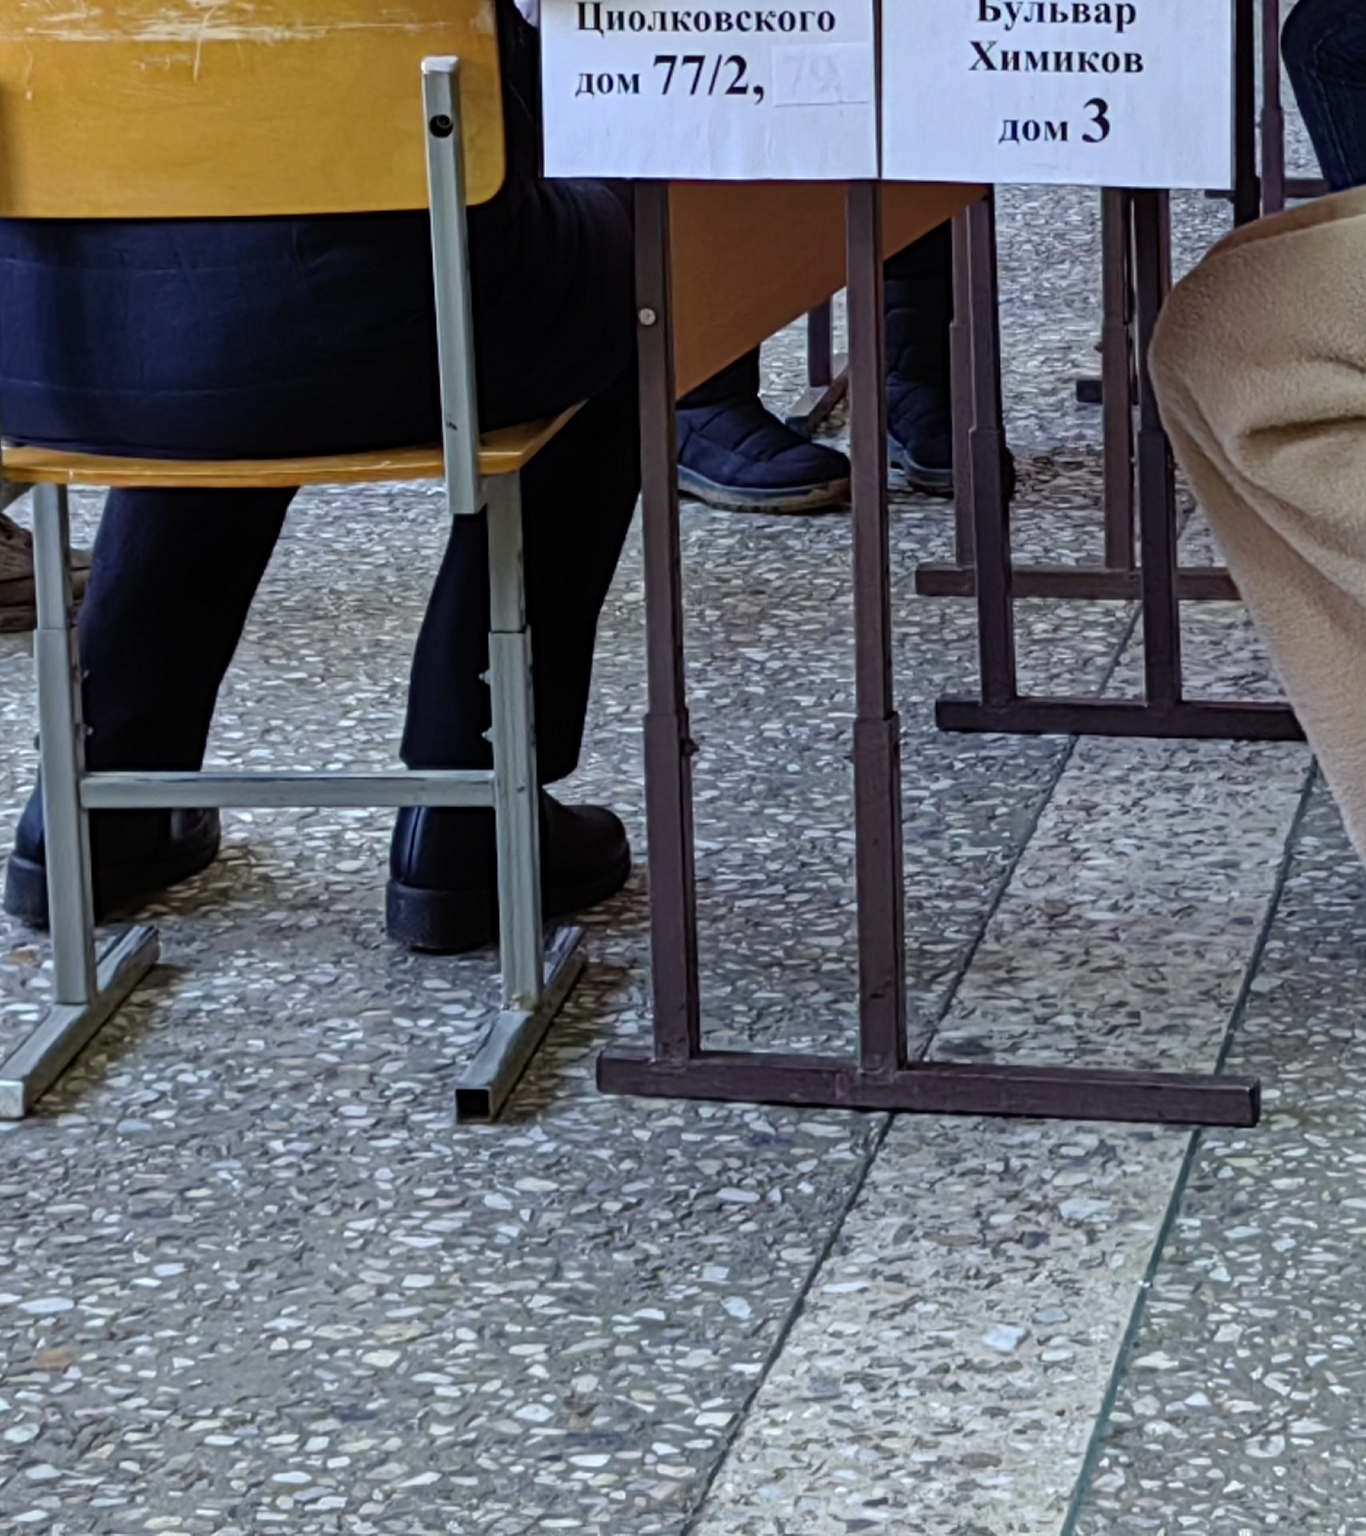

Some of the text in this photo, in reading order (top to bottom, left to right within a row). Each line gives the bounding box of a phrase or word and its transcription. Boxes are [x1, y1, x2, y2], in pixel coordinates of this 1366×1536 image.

[575, 1, 837, 38] Циолковского
[968, 39, 1145, 74] Химиков
[575, 72, 641, 98] дом
[652, 53, 766, 105] 77/2,
[998, 96, 1112, 145] дом 3
